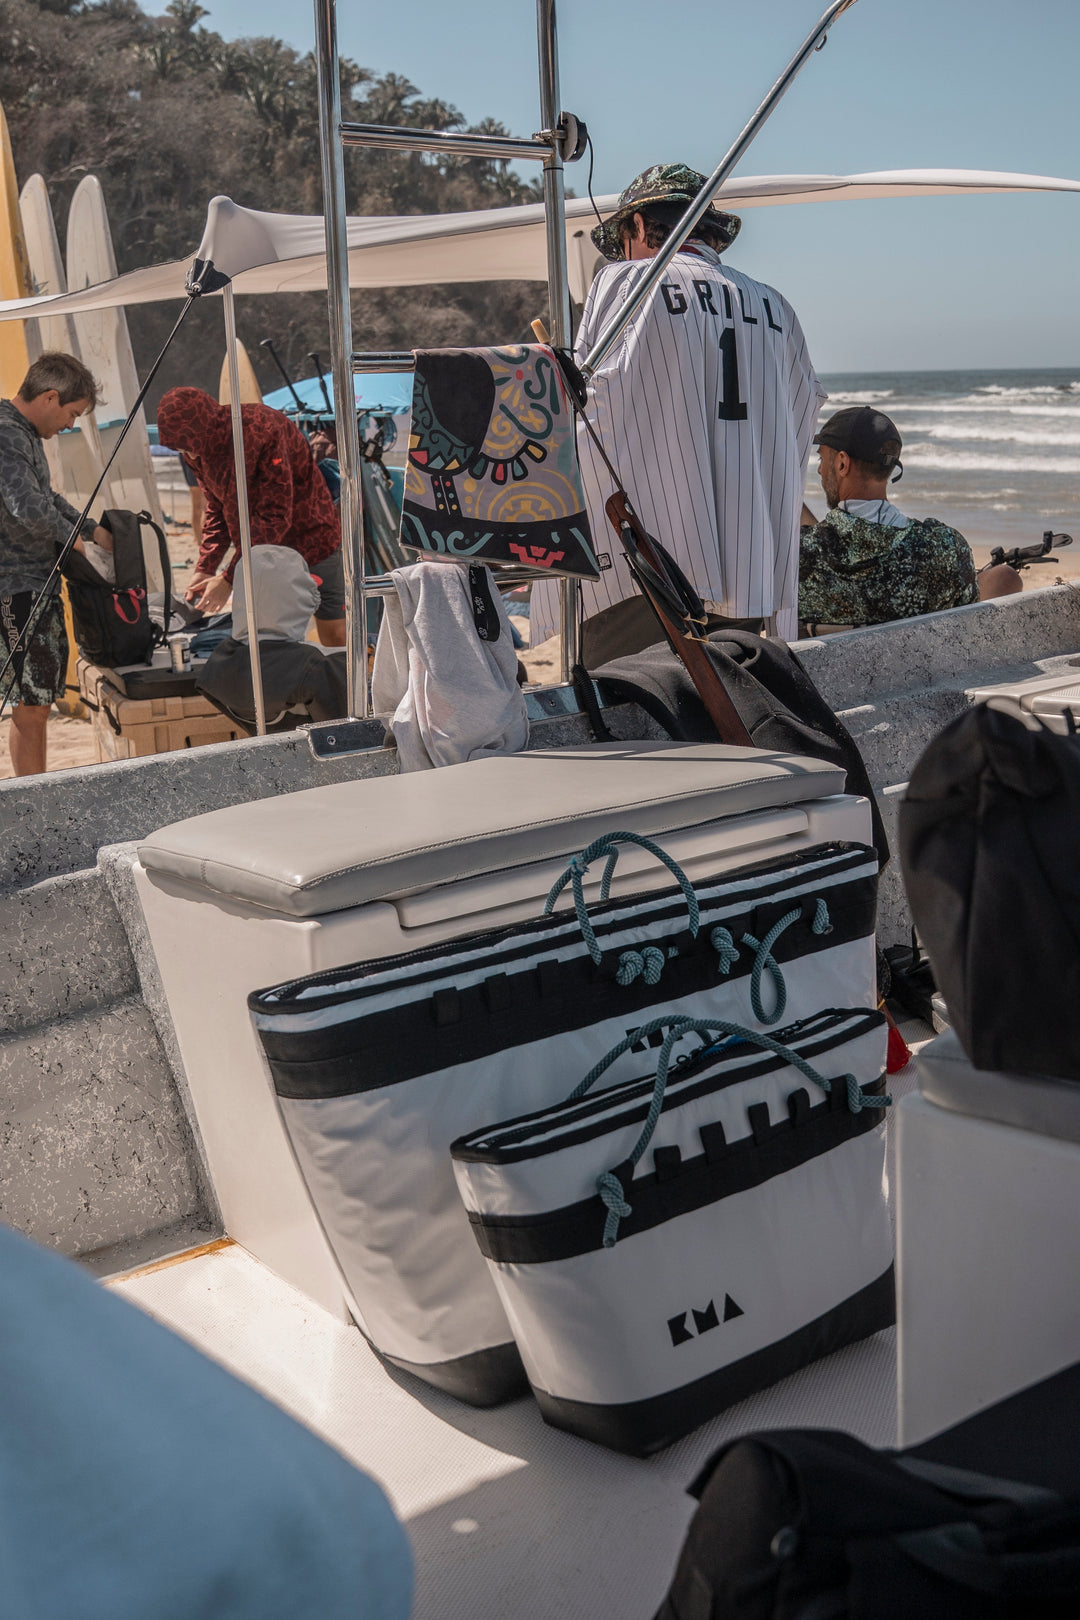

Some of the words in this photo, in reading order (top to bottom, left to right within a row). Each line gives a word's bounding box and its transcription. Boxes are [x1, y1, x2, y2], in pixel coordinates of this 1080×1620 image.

[661, 279, 783, 334] GRILL
[718, 327, 748, 421] 1
[667, 1292, 745, 1347] KMA
